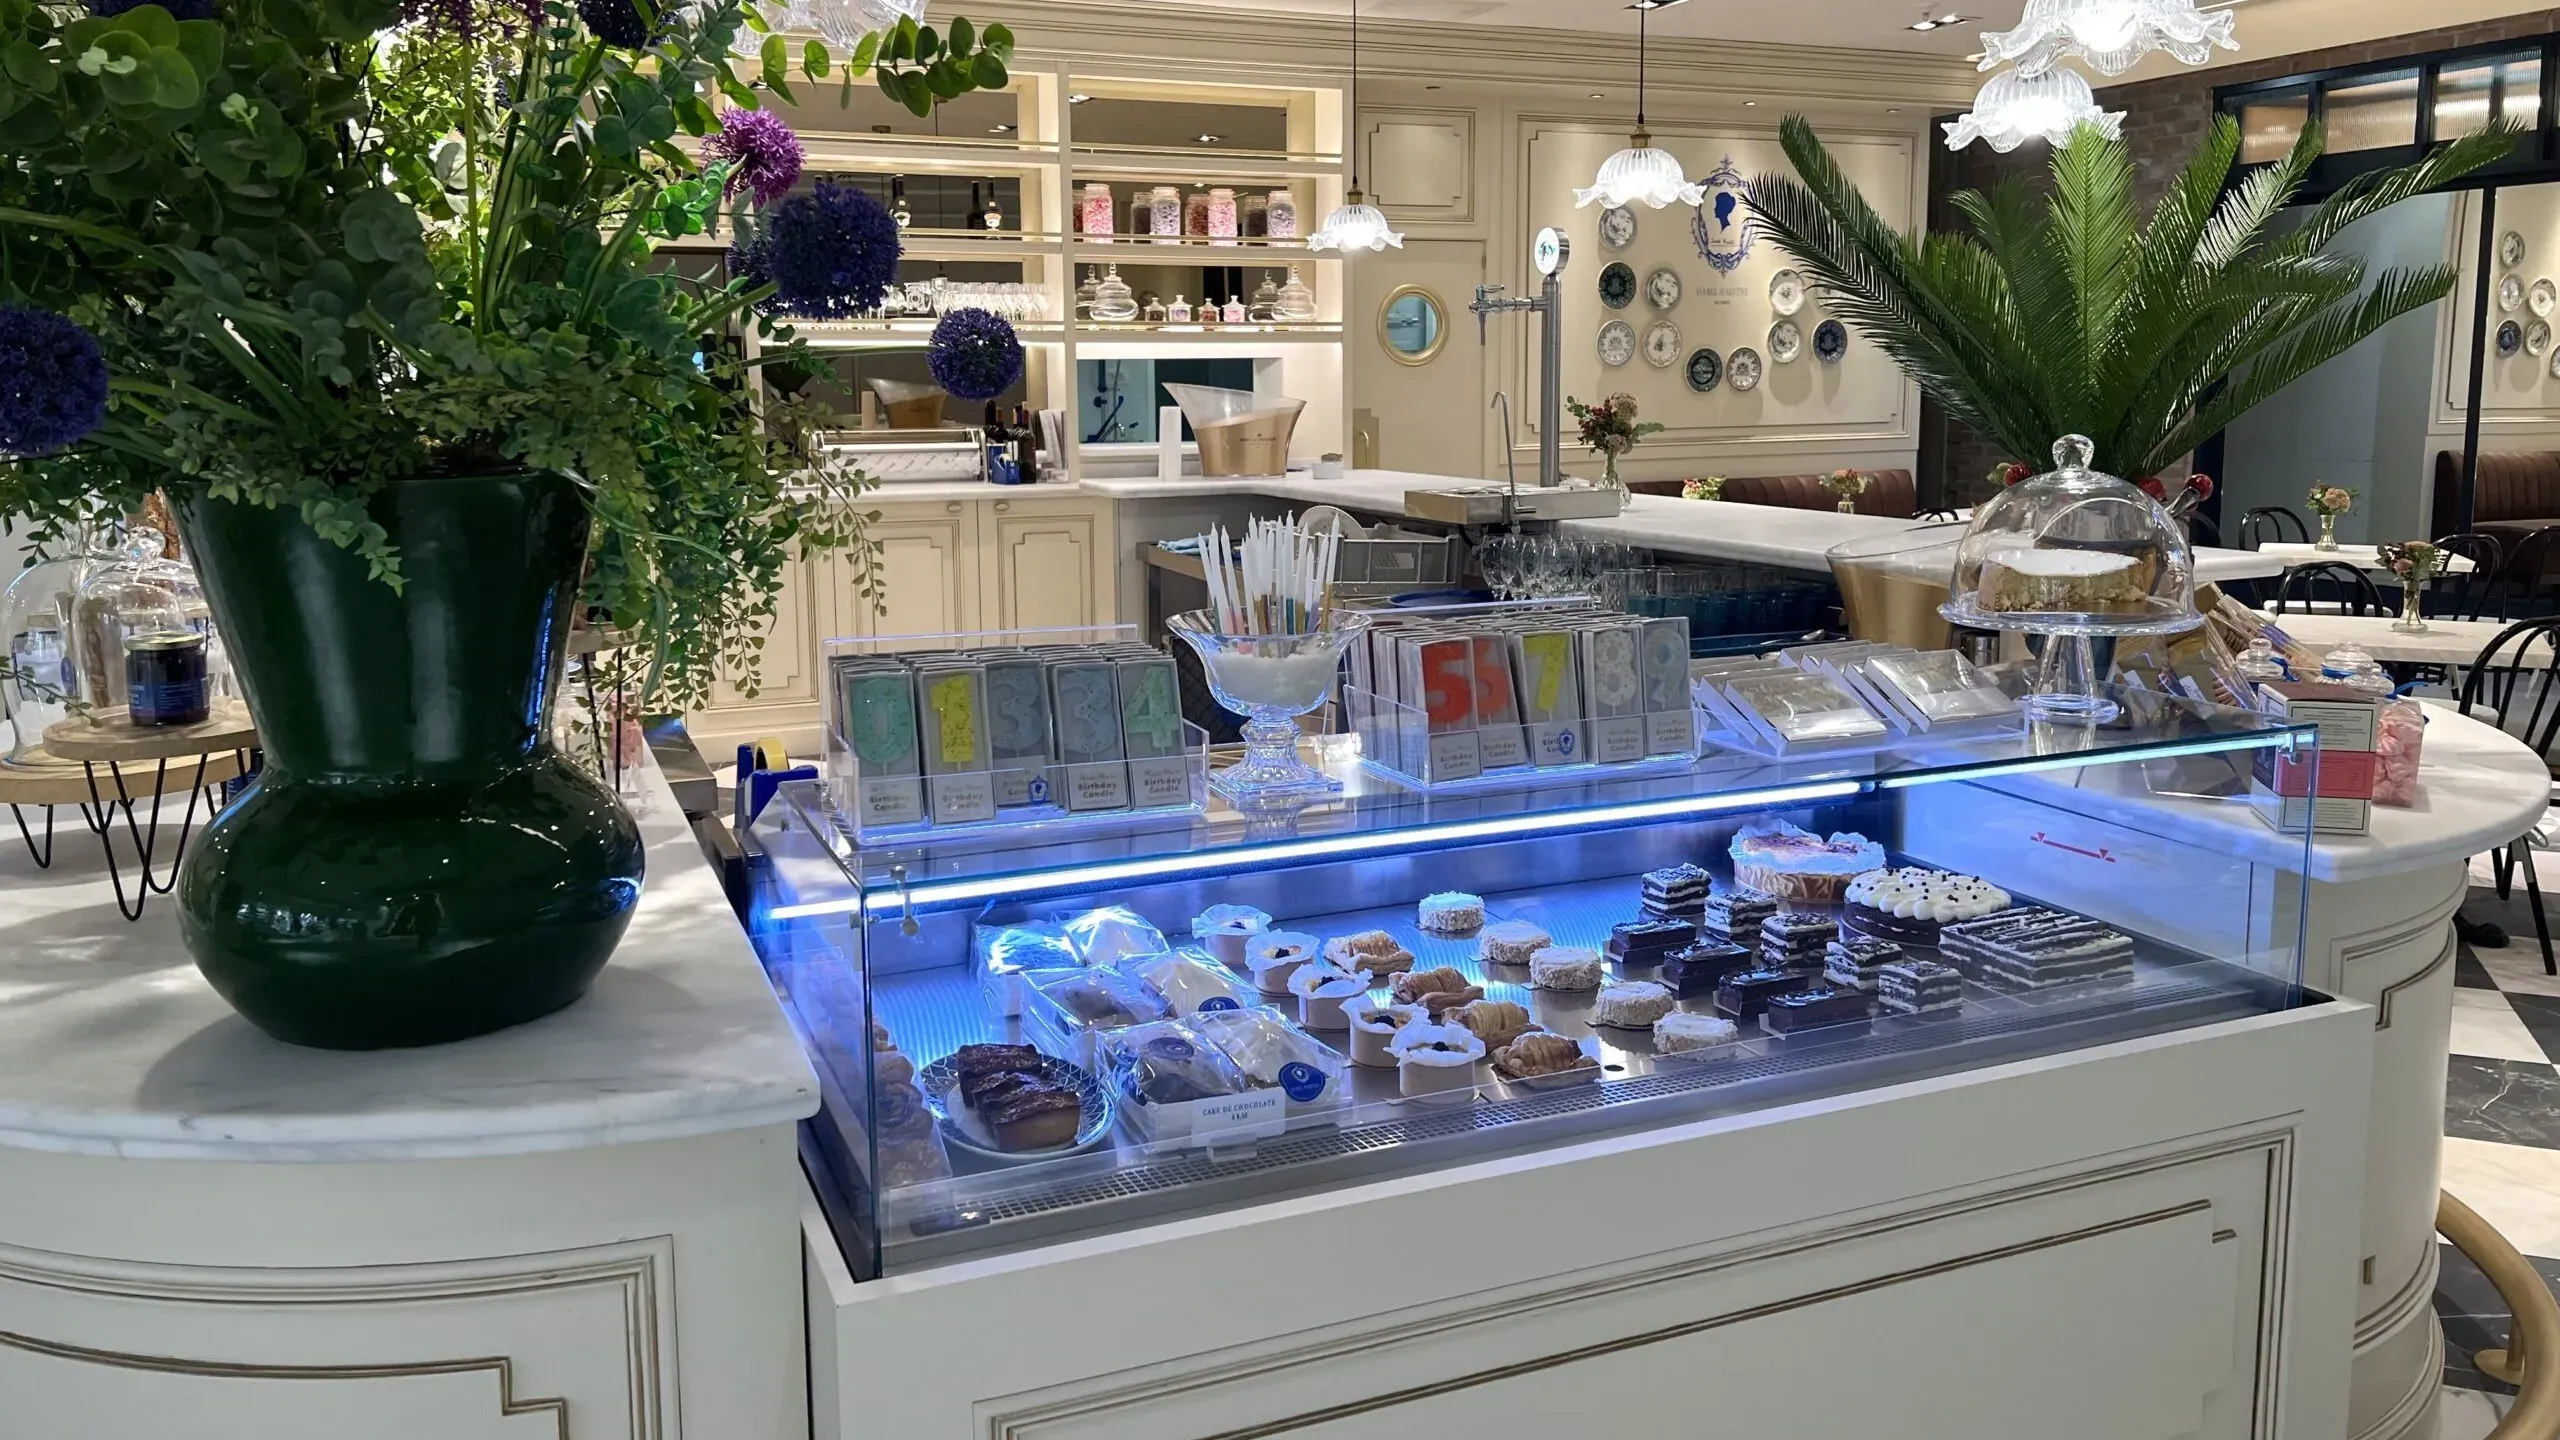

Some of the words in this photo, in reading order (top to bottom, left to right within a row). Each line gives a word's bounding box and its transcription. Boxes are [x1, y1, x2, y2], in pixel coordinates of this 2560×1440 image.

[1124, 666, 1179, 748] 4
[1422, 641, 1472, 723] 5
[1523, 633, 1568, 711] 7
[931, 674, 974, 763] 1
[1078, 781, 1117, 791] Birthday
[1203, 1106, 1220, 1116] CAKE
